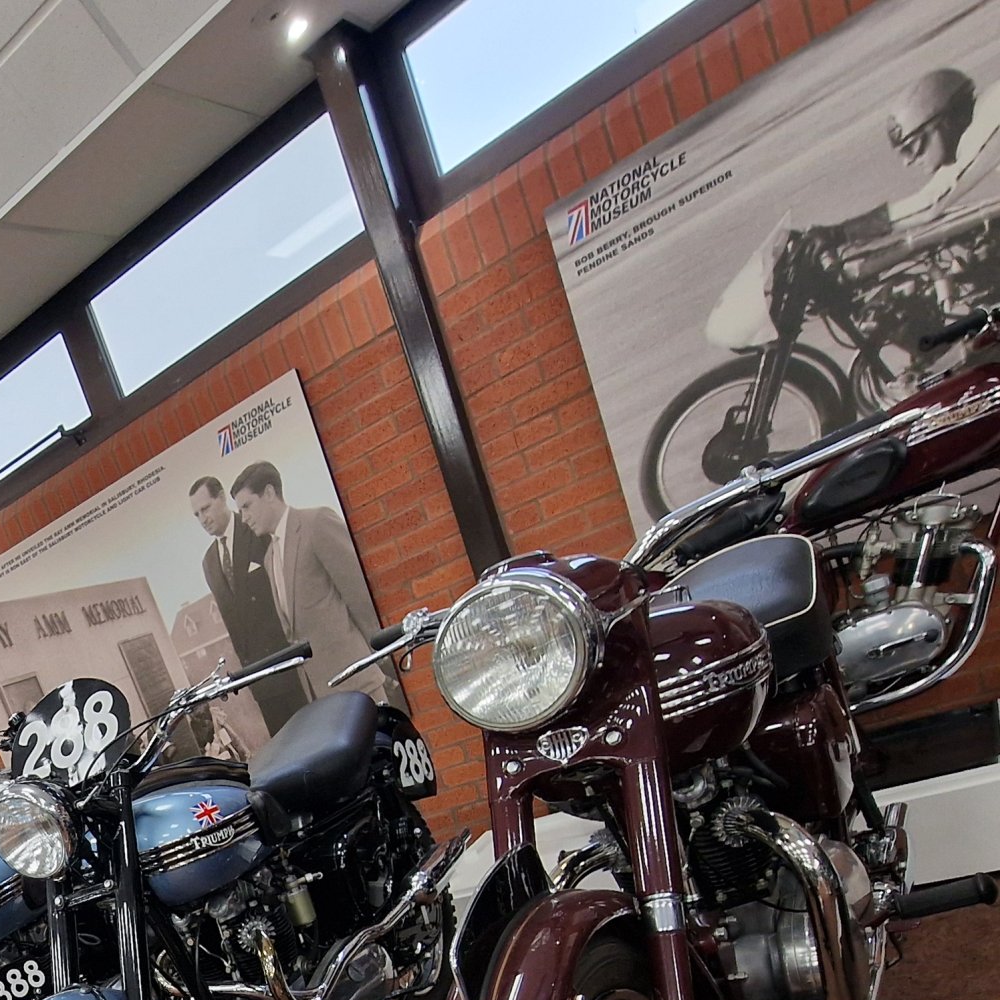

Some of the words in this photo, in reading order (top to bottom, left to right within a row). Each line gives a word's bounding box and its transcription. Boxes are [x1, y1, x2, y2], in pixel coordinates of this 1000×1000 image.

[589, 155, 661, 207] NATIONAL
[589, 151, 687, 220] MOTORCYCLE
[574, 251, 595, 268] BOB
[597, 231, 631, 256] BERRY,
[633, 205, 676, 232] BROUGH
[678, 170, 733, 207] SUPERIOR
[590, 188, 653, 234] MUSEUM
[576, 249, 619, 277] PENDINE
[621, 228, 655, 251] SANDS
[231, 397, 276, 430] NATIONAL
[232, 396, 293, 439] MOTORCYCLE
[234, 420, 273, 449] MUSEUM
[1, 559, 14, 571] AFTER
[44, 534, 54, 544] THE
[54, 529, 63, 538] RAY
[75, 505, 101, 524] MEMORIAL
[39, 546, 48, 554] THE
[74, 510, 106, 532] MOTORCYCLE
[106, 503, 118, 513] AND
[118, 493, 134, 505] LIGHT
[134, 485, 145, 496] CAR
[146, 476, 161, 488] CLUB
[33, 610, 73, 640] AMM
[81, 595, 147, 627] MEMORIAL
[393, 738, 434, 788] 288
[190, 825, 235, 850] TRIUMPH
